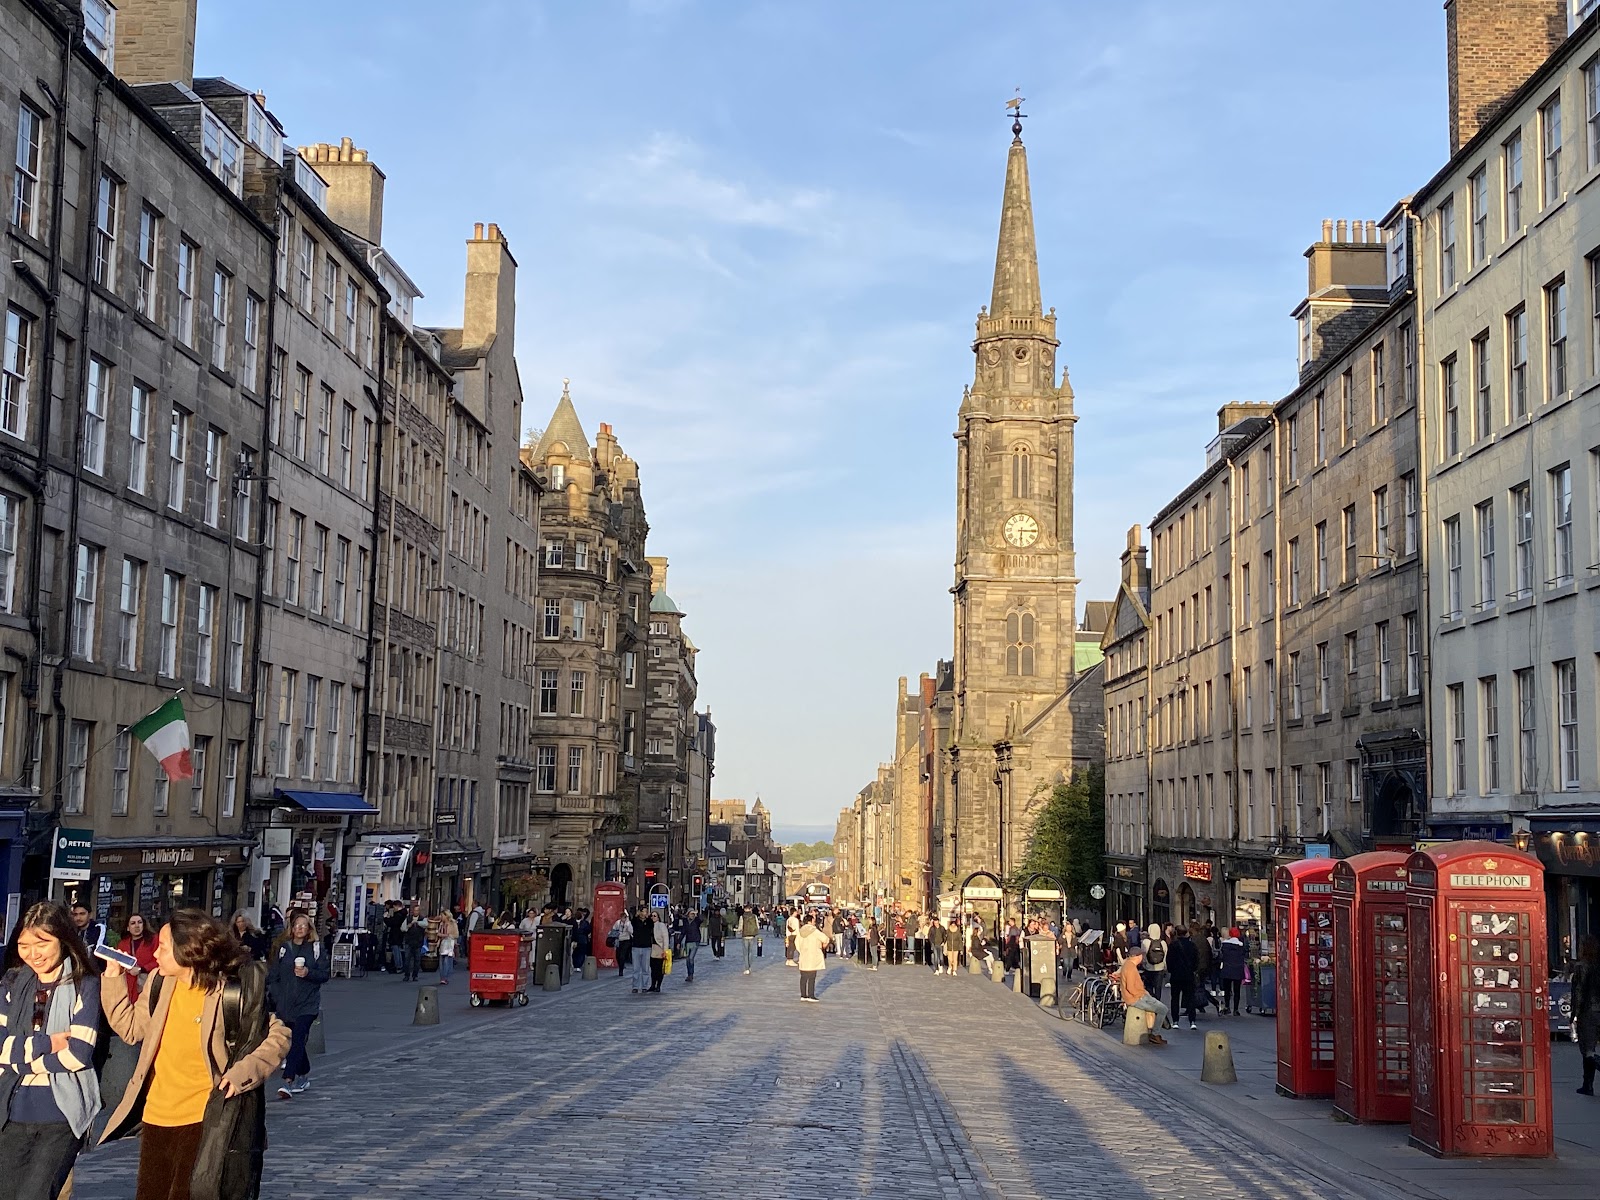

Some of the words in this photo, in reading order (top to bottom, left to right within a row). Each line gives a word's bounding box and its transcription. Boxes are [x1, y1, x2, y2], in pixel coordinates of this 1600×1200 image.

[68, 840, 92, 848] RETTIE
[141, 849, 155, 864] The
[155, 848, 180, 867] Whisky
[180, 848, 195, 863] Trail
[1454, 875, 1528, 887] TELEPHONE
